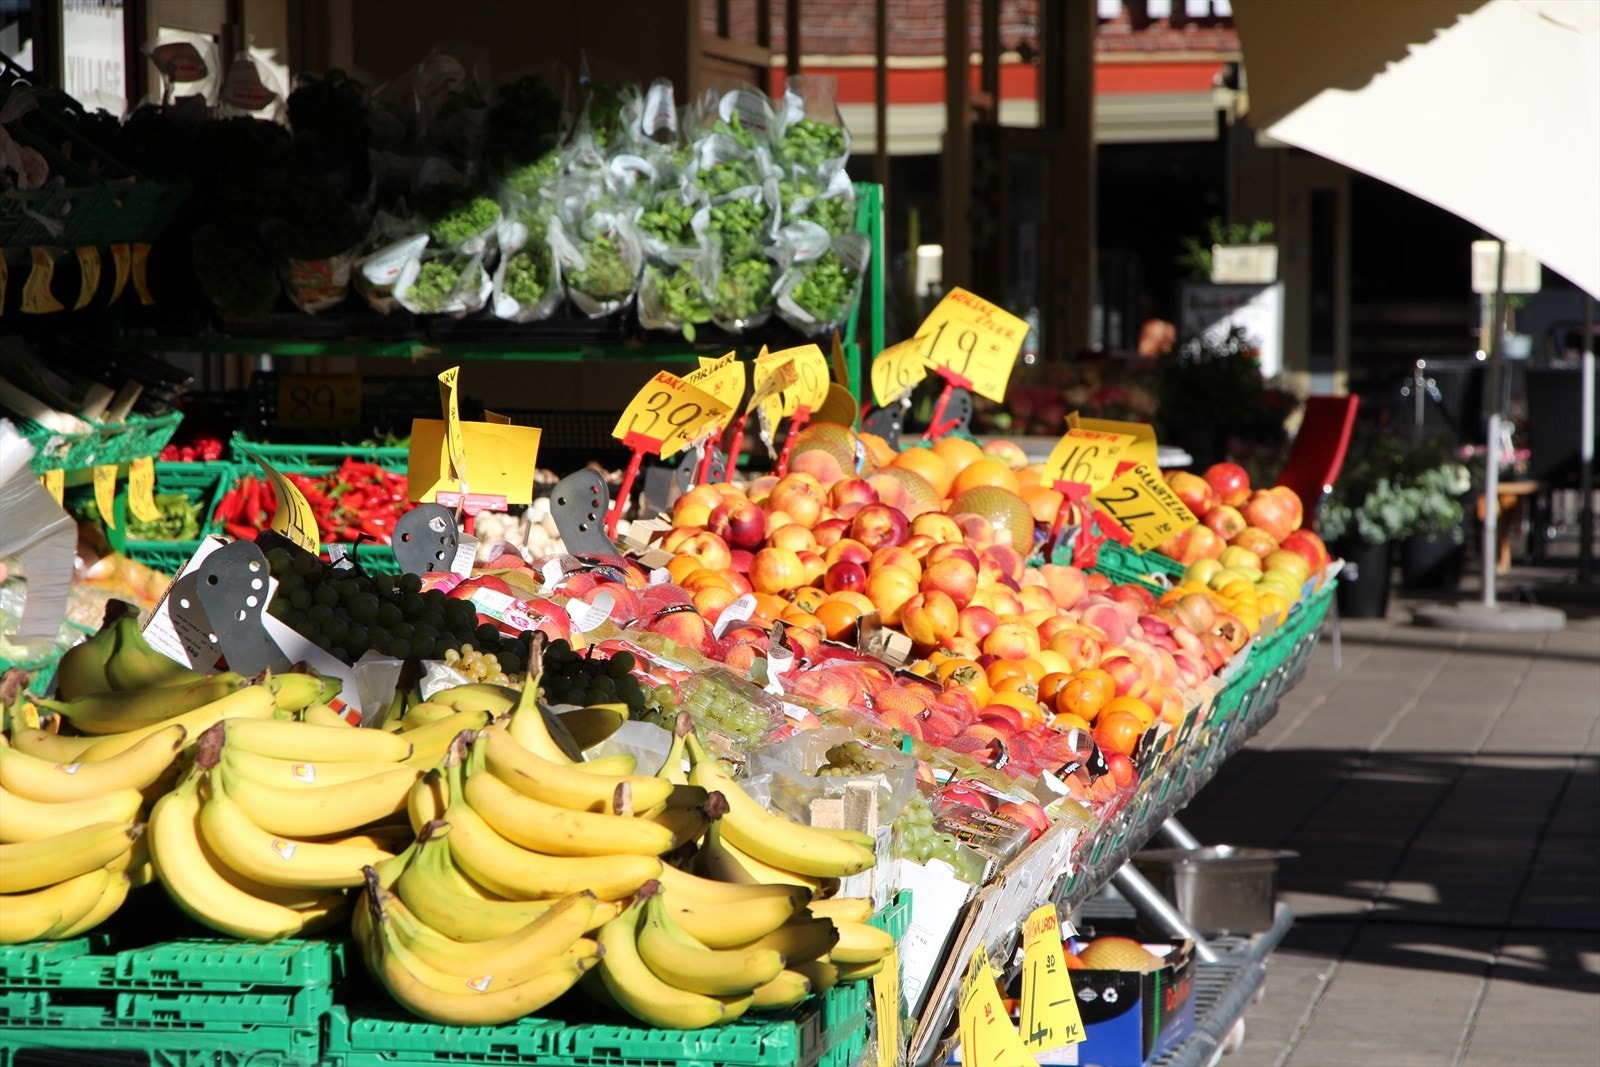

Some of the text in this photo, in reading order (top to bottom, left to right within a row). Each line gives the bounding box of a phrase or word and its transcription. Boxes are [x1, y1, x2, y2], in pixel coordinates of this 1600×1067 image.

[67, 54, 121, 97] VILLAGE
[926, 320, 979, 377] 19
[689, 354, 734, 386] TARINER
[289, 385, 335, 423] 89
[628, 391, 703, 445] 39
[1060, 445, 1100, 483] 16
[184, 644, 200, 658] 5kg
